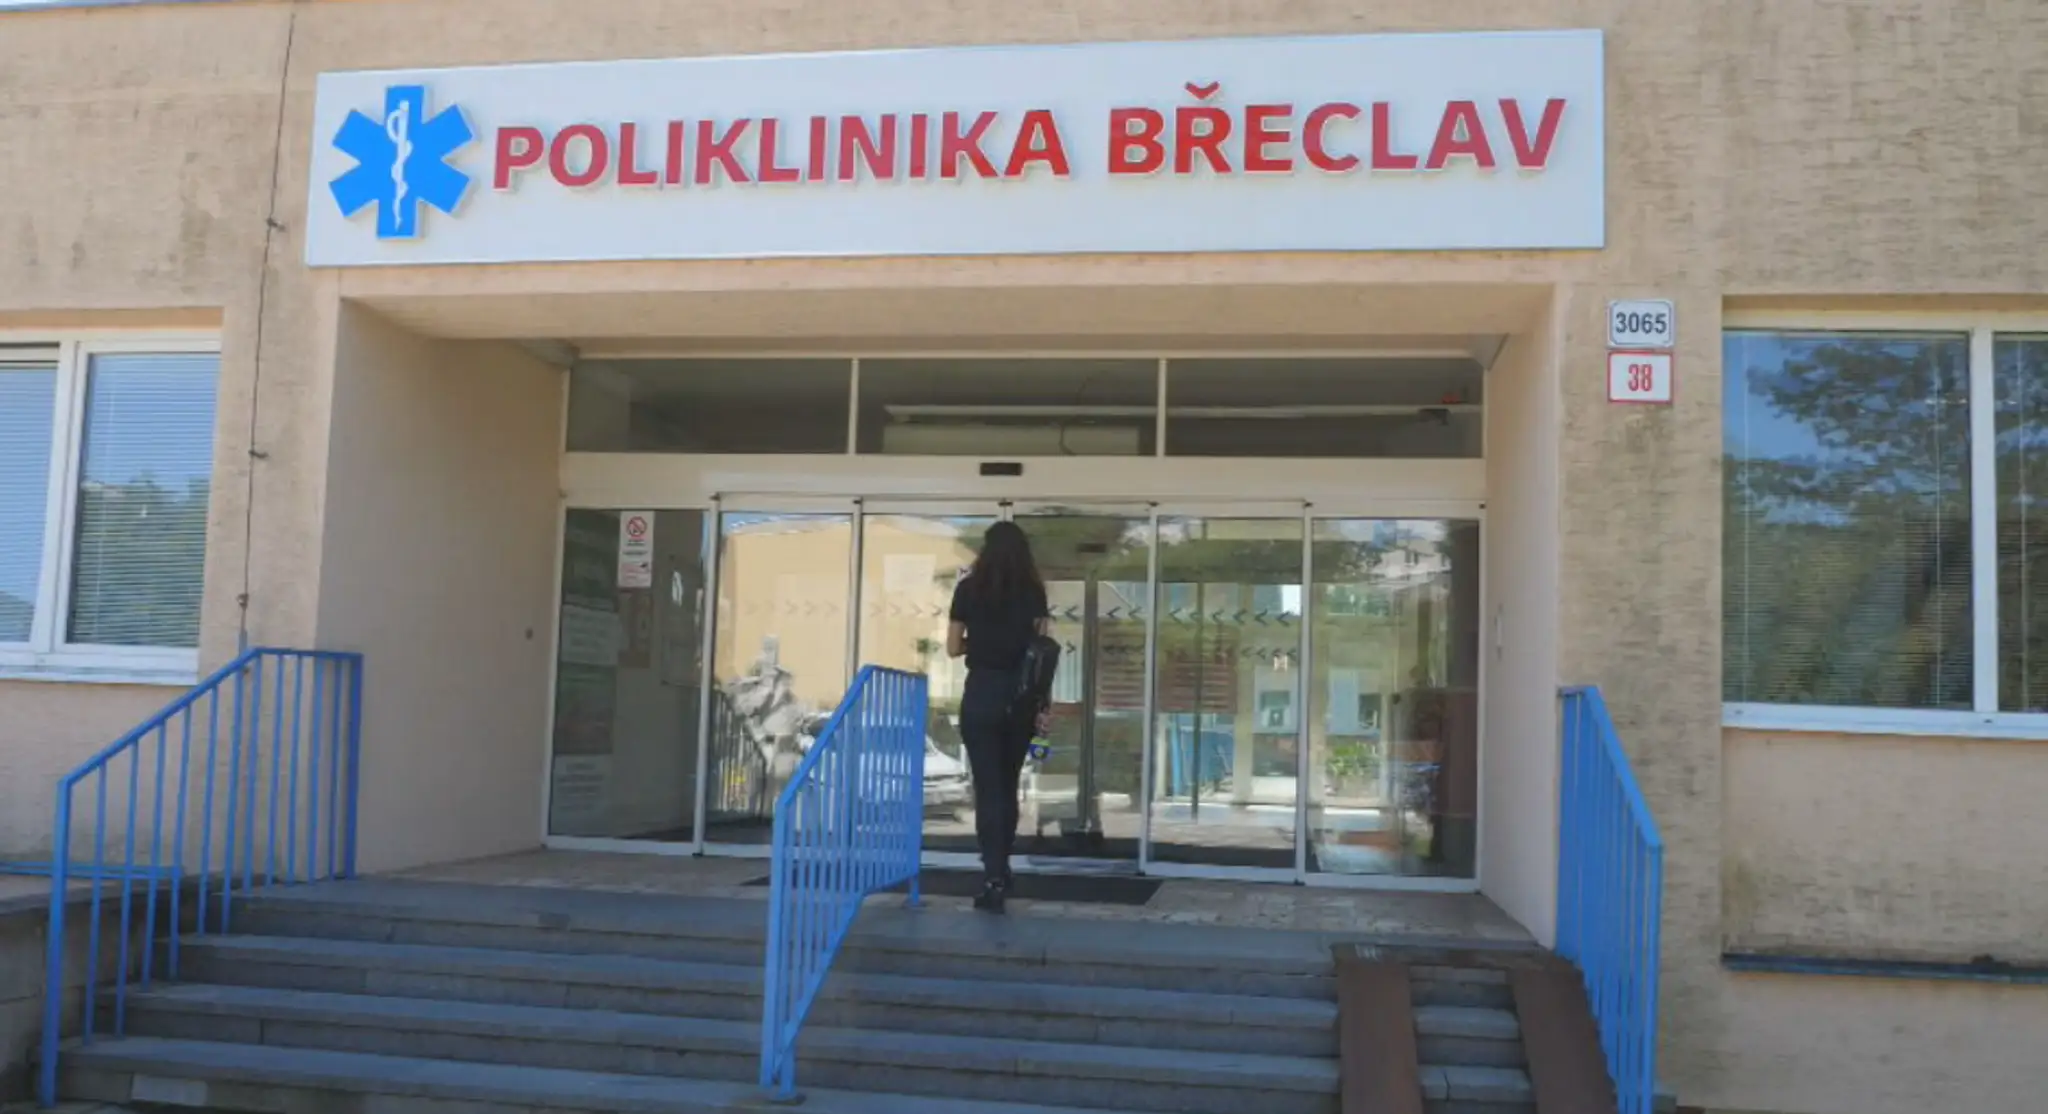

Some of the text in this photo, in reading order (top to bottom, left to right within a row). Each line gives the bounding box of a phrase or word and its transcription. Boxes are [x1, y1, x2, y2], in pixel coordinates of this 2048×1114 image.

[494, 81, 1565, 189] POLIKLINIKA BŘECLAV
[1615, 311, 1667, 334] 3065
[1628, 363, 1653, 392] 38
